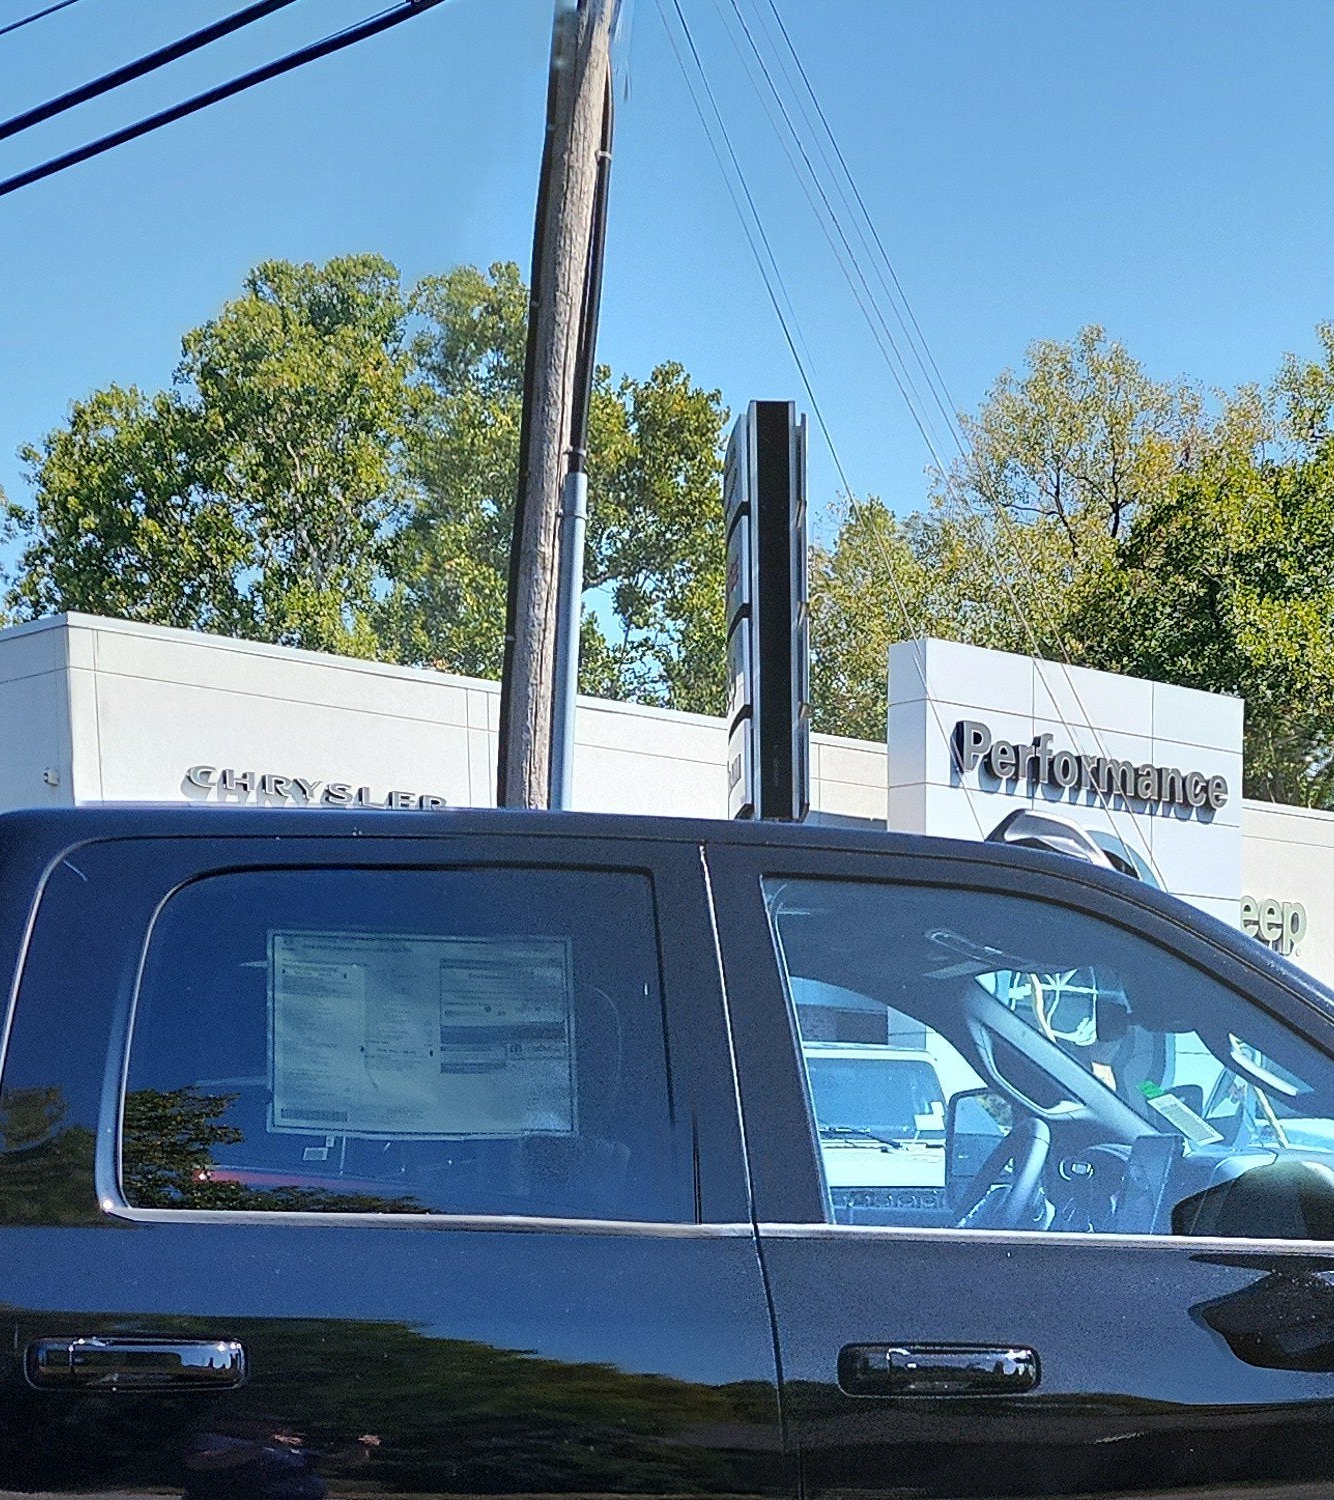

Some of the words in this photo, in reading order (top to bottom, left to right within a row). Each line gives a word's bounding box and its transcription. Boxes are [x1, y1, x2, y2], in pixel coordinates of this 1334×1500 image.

[184, 765, 448, 811] CHRYSLER
[953, 720, 1229, 810] Performance
[1241, 895, 1307, 951] eep
